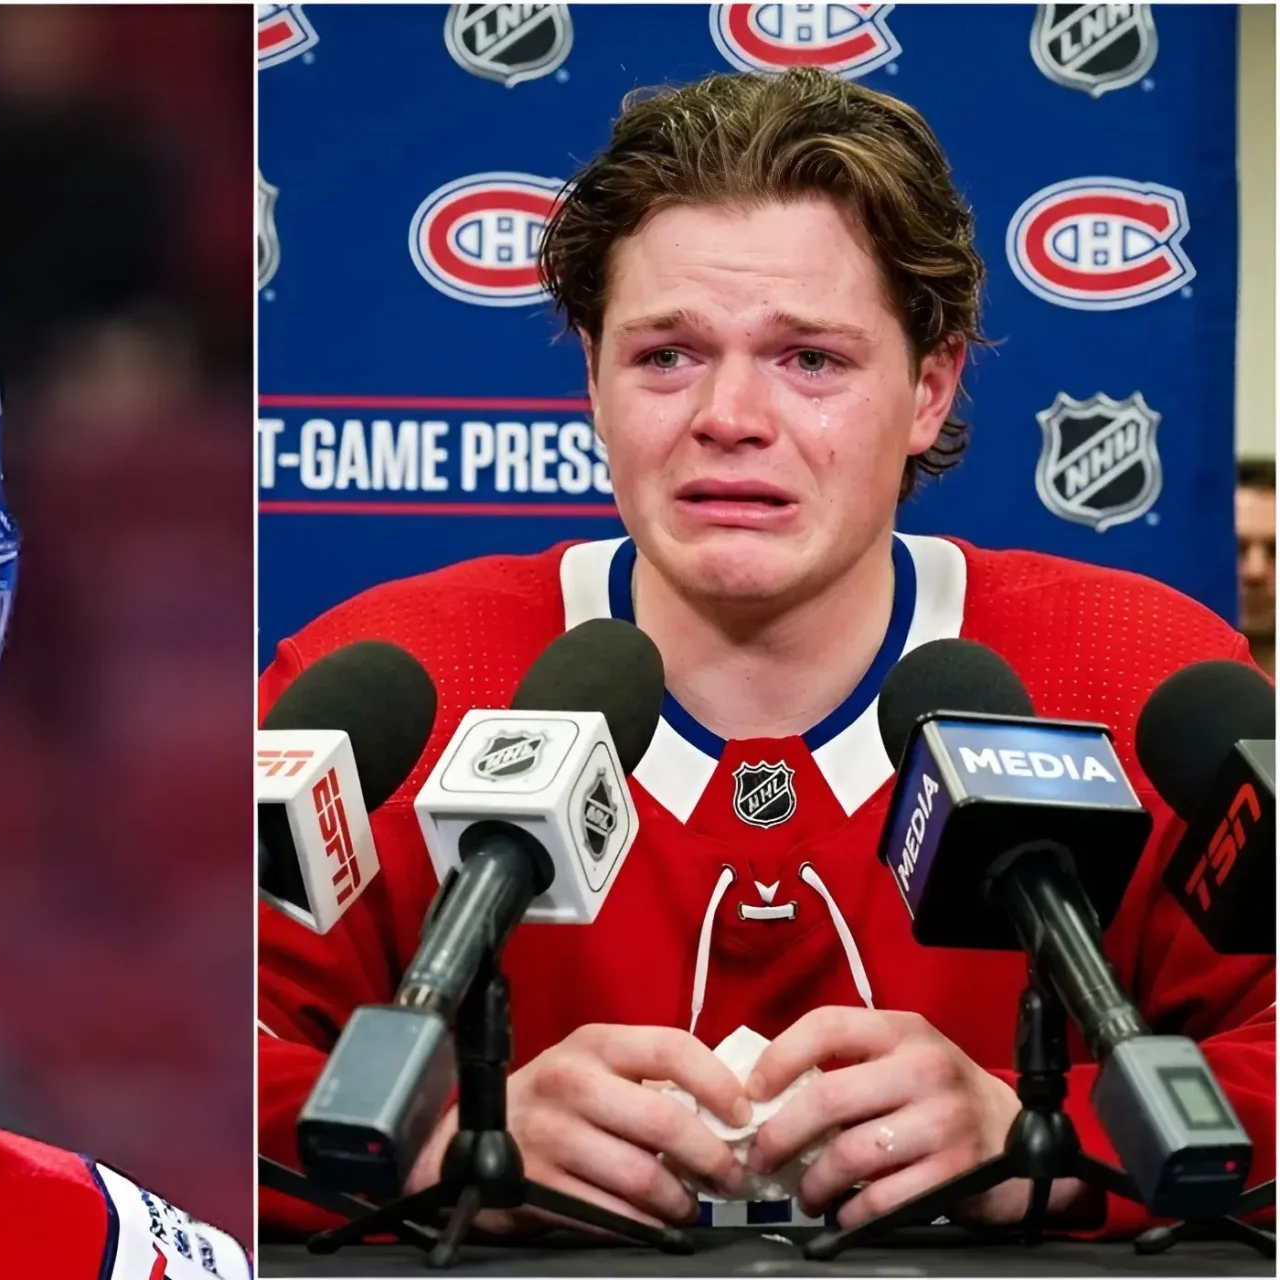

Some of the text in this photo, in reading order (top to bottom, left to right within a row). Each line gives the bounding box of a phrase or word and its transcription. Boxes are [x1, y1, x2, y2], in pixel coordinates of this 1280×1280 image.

[748, 777, 787, 814] NHL
[958, 747, 1117, 783] MEDIA
[312, 767, 362, 906] ESPN
[897, 773, 940, 892] MEDIA
[1184, 783, 1262, 912] TSN
